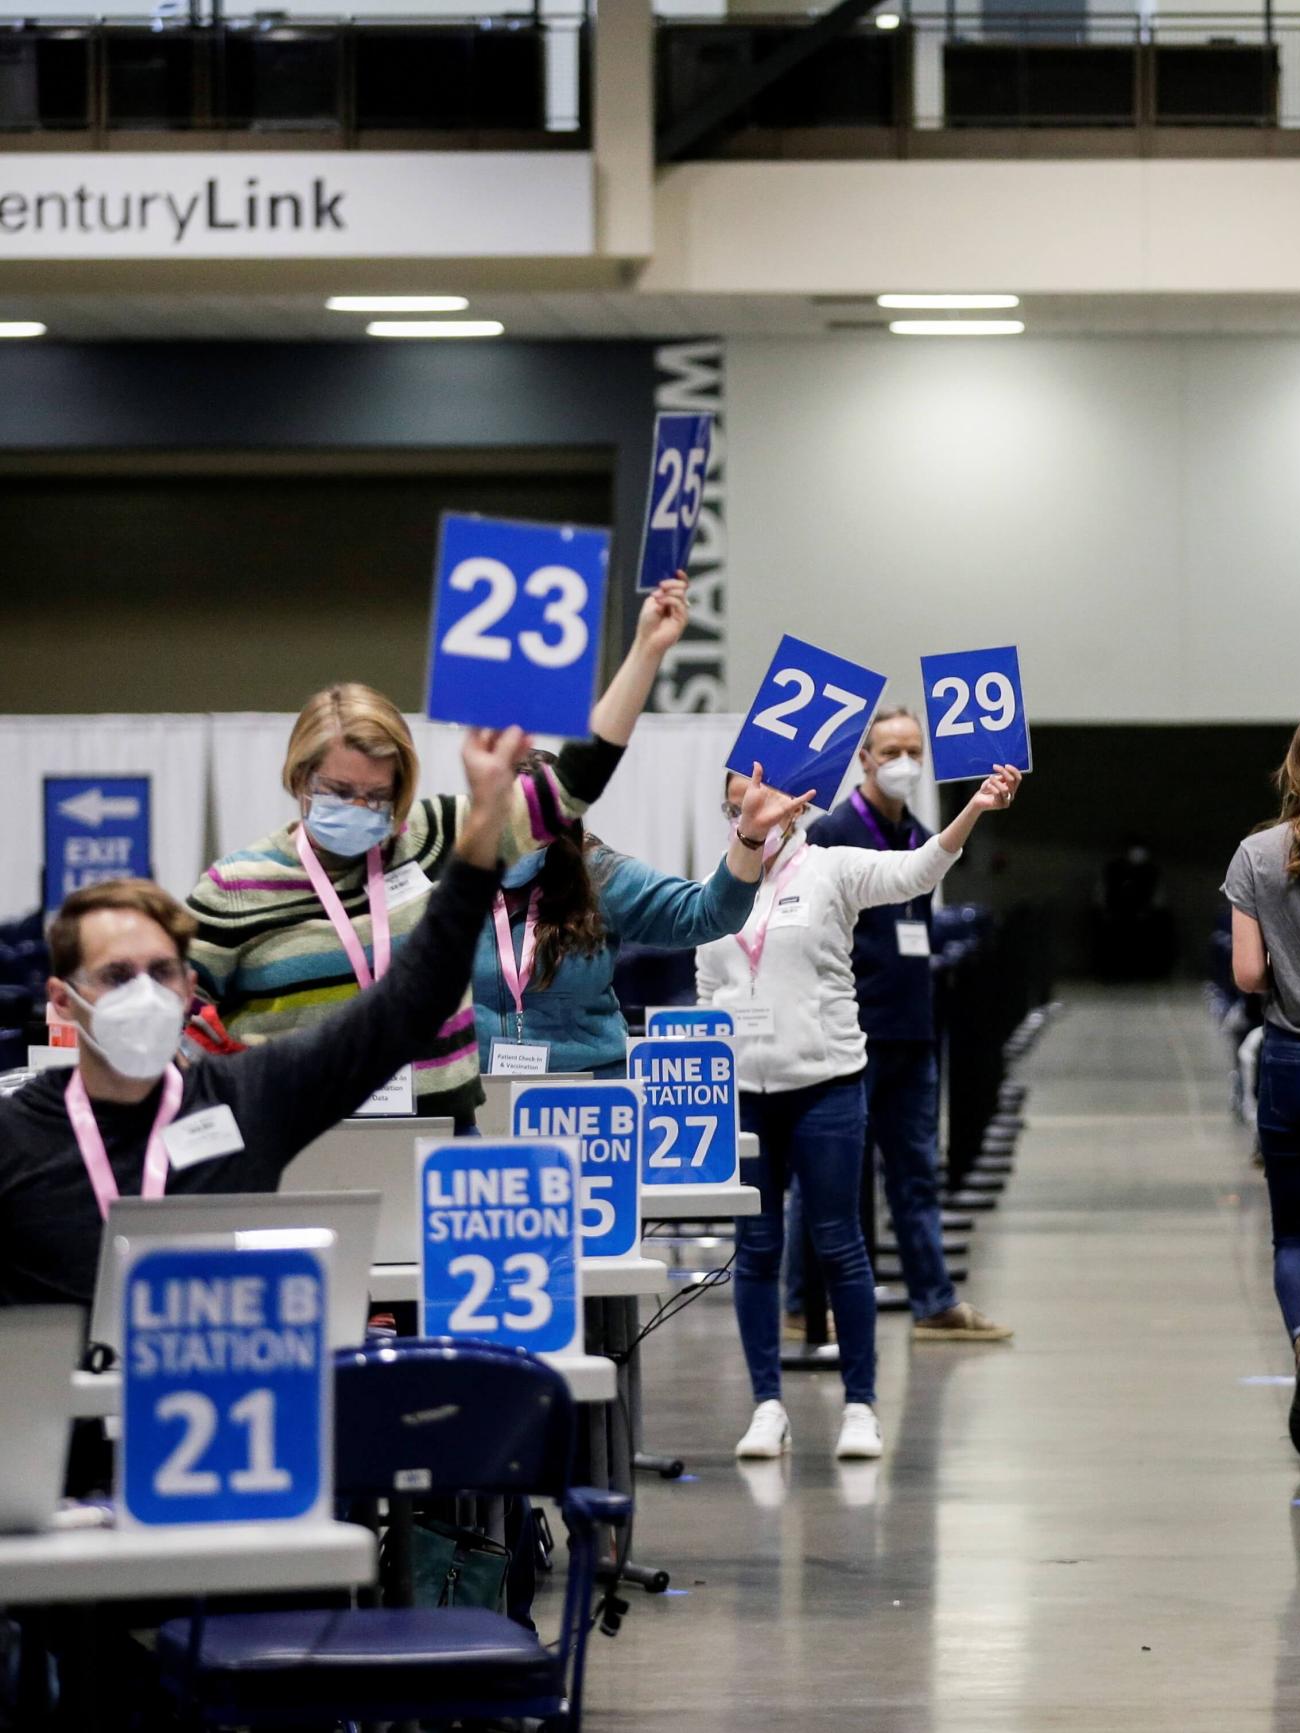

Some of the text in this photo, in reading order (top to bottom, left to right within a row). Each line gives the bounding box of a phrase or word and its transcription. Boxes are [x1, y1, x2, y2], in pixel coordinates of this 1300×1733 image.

[651, 448, 705, 529] 25
[441, 556, 588, 668] 23
[752, 668, 867, 751] 27
[931, 672, 1016, 737] 29
[65, 836, 133, 864] EXIT
[634, 1057, 731, 1082] LINE B
[520, 1106, 634, 1135] LINE B
[649, 1116, 717, 1168] 27
[426, 1167, 571, 1207] LINE B
[428, 1208, 570, 1242] STATION
[132, 1273, 319, 1329] LINE B
[449, 1252, 552, 1332] 23
[132, 1327, 316, 1378] STATION
[152, 1388, 293, 1496] 21
